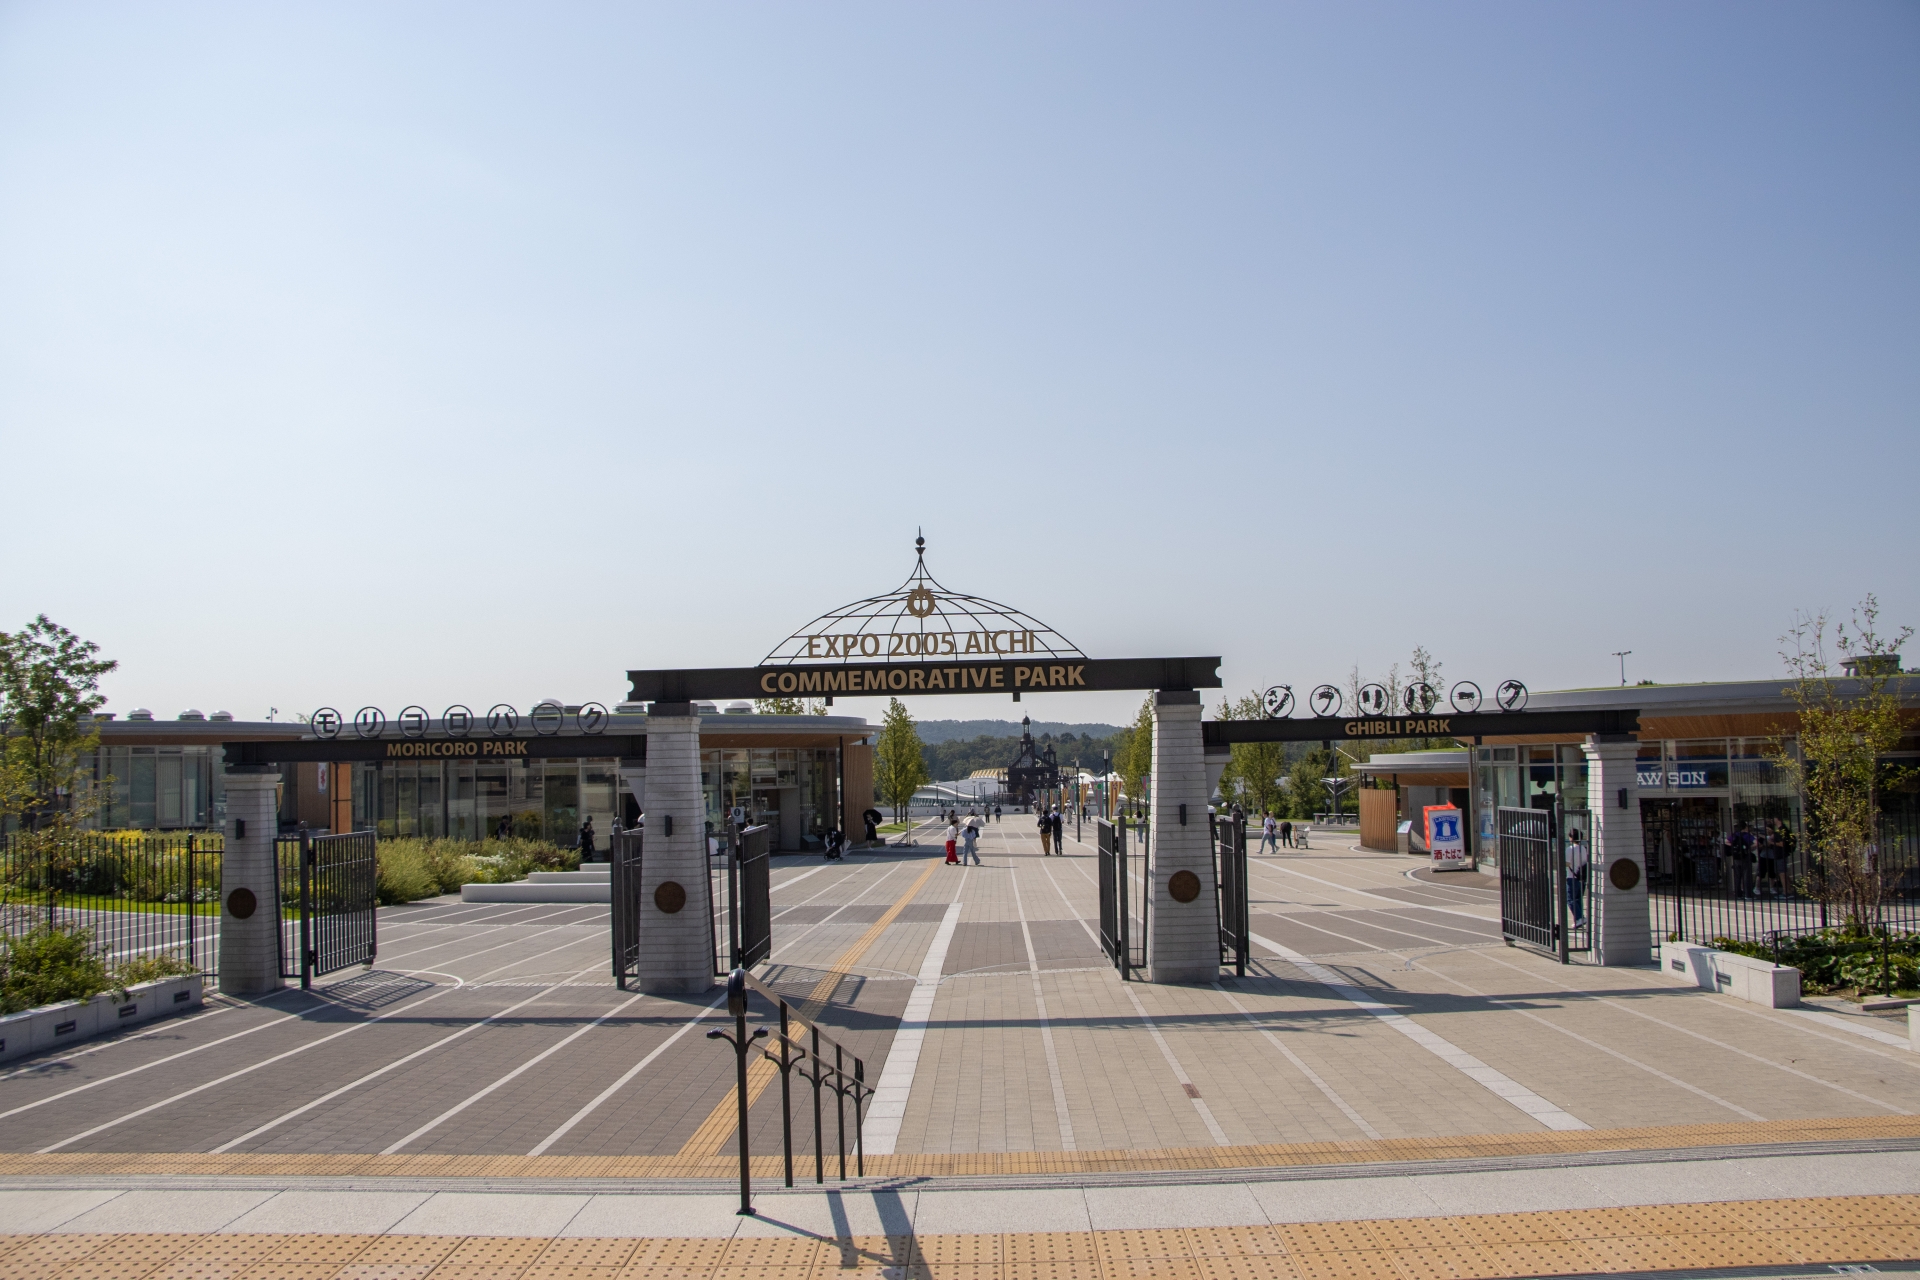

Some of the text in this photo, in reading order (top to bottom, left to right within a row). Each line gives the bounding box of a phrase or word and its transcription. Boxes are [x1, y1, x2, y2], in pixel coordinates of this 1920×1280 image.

[807, 629, 1035, 659] EXPO 2005 AICHI
[760, 665, 1086, 693] COMMEMORATIVE PARK
[312, 703, 608, 737] モリコロパーク
[1345, 719, 1450, 736] GHIBLI PARK
[386, 741, 528, 757] MORICORO PARK
[1636, 771, 1706, 785] AWSON
